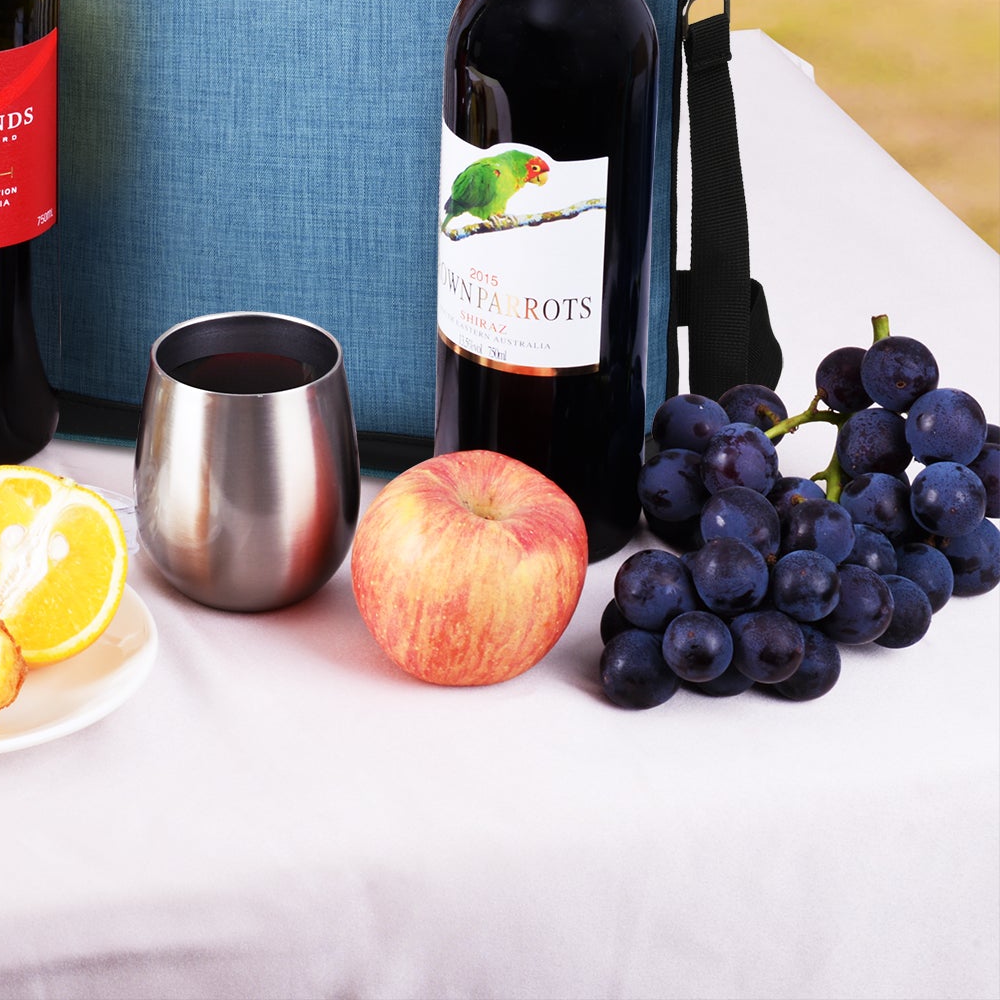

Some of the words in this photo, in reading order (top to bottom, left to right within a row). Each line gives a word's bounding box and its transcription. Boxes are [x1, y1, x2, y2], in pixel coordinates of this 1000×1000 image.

[470, 267, 499, 286] 2015
[439, 261, 473, 304] OWN
[476, 286, 592, 322] PARROTS
[459, 310, 508, 336] SHIRAZ
[493, 335, 552, 350] AUSTRALIA
